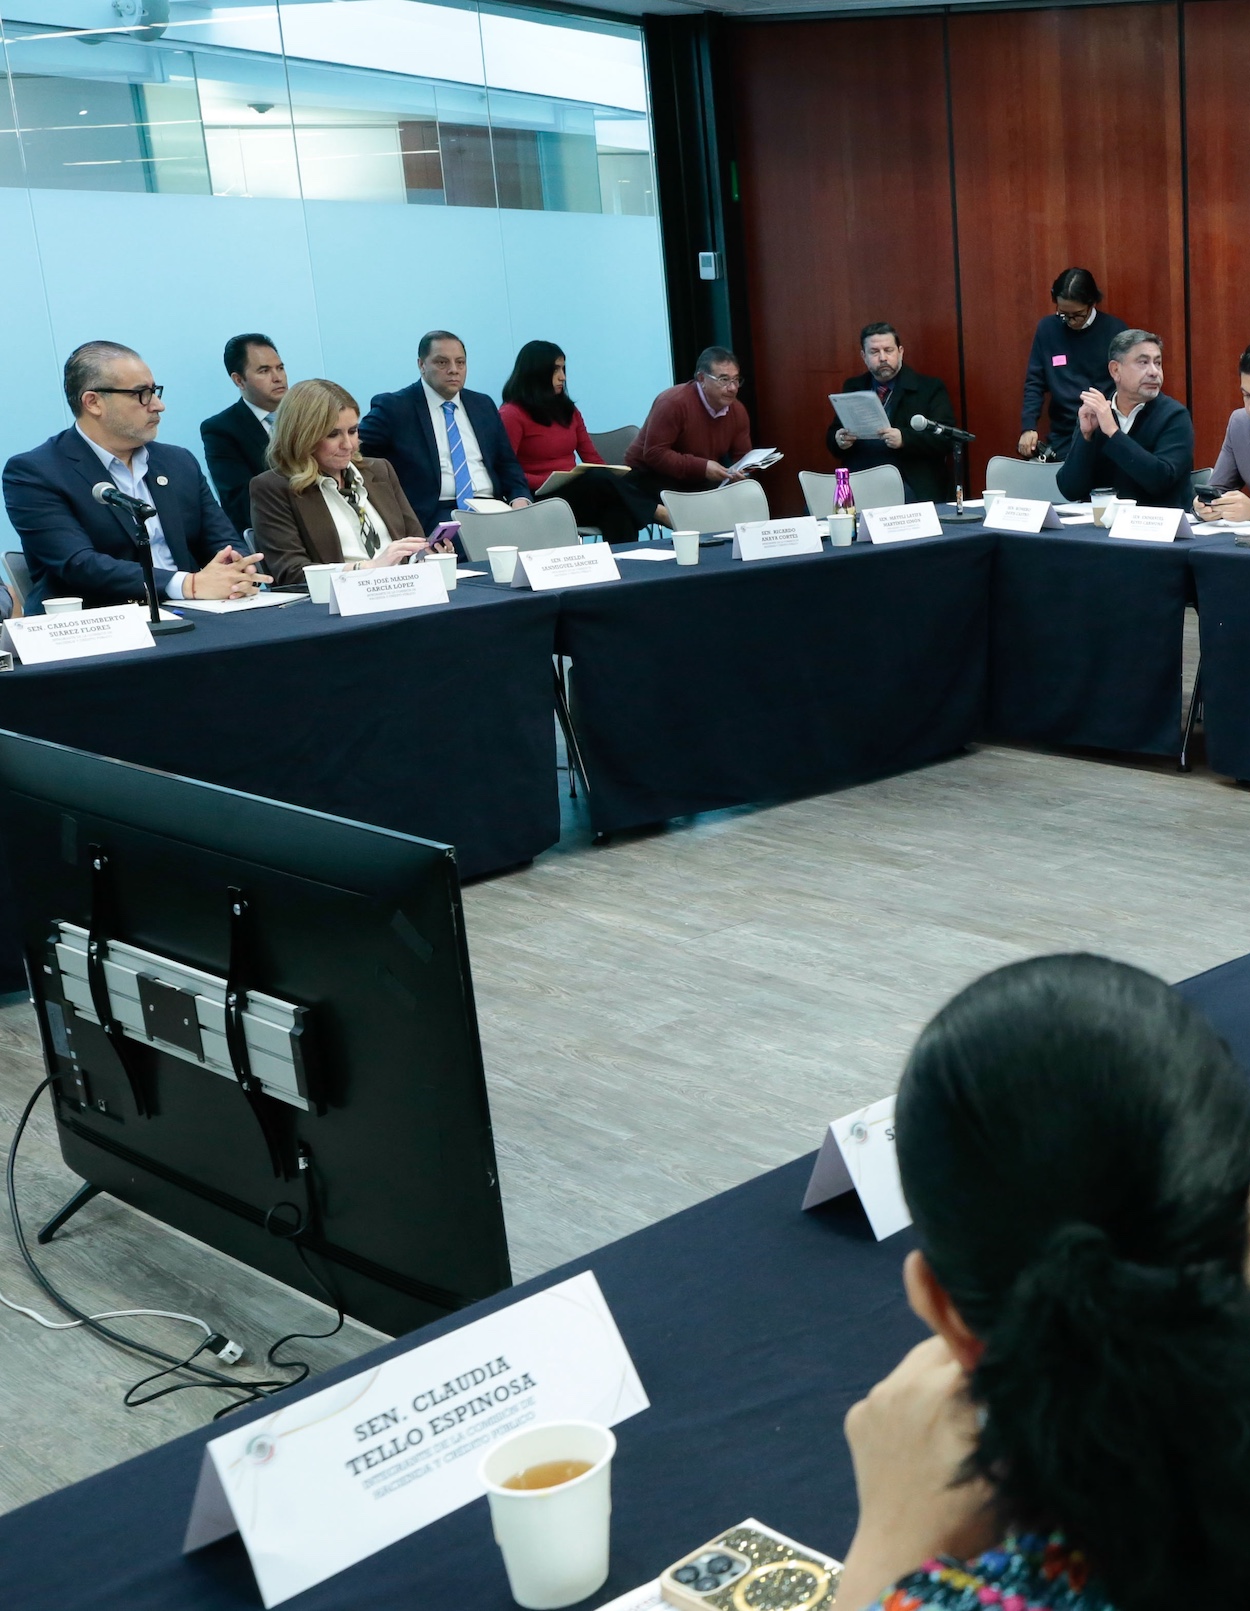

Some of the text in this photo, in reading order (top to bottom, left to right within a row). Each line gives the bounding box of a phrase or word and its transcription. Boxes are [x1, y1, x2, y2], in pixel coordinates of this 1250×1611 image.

[373, 577, 389, 585] JOSÉ
[27, 614, 126, 633] SEN. CARLOS HUMBERTO
[81, 624, 111, 633] FLORES
[354, 1356, 512, 1443] SEN. CLAUDIA
[345, 1372, 537, 1476] TELLO ESPINOSA
